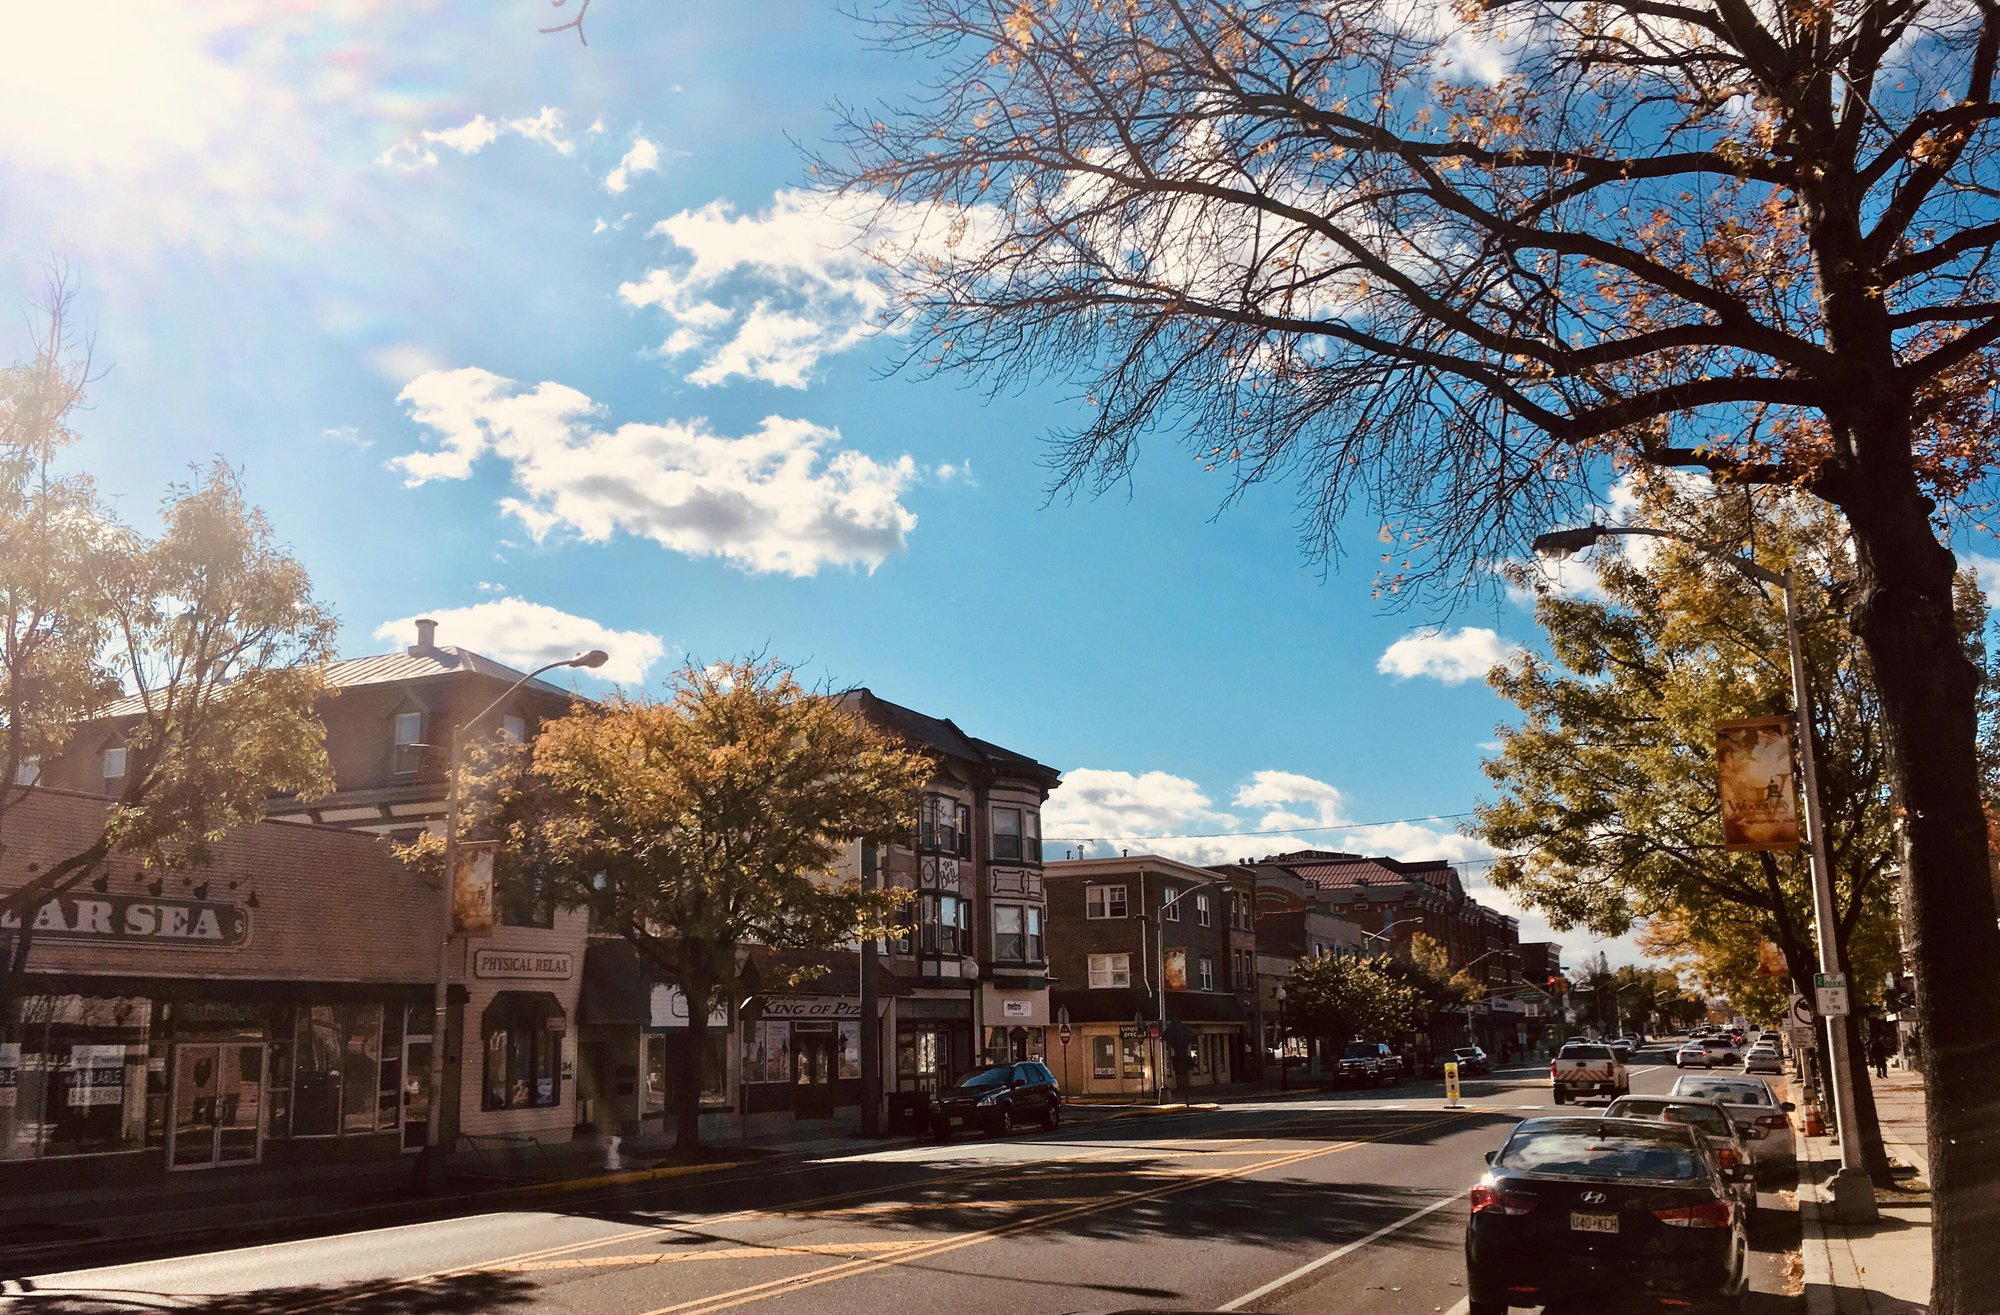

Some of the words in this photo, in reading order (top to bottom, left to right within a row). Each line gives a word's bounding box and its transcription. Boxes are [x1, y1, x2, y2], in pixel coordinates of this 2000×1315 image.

[481, 956, 533, 971] PHYSICAL
[536, 959, 568, 972] RELAX
[763, 1001, 805, 1015] KING
[809, 1004, 832, 1014] OF
[832, 1002, 864, 1015] PIZ
[1007, 1003, 1022, 1011] metro
